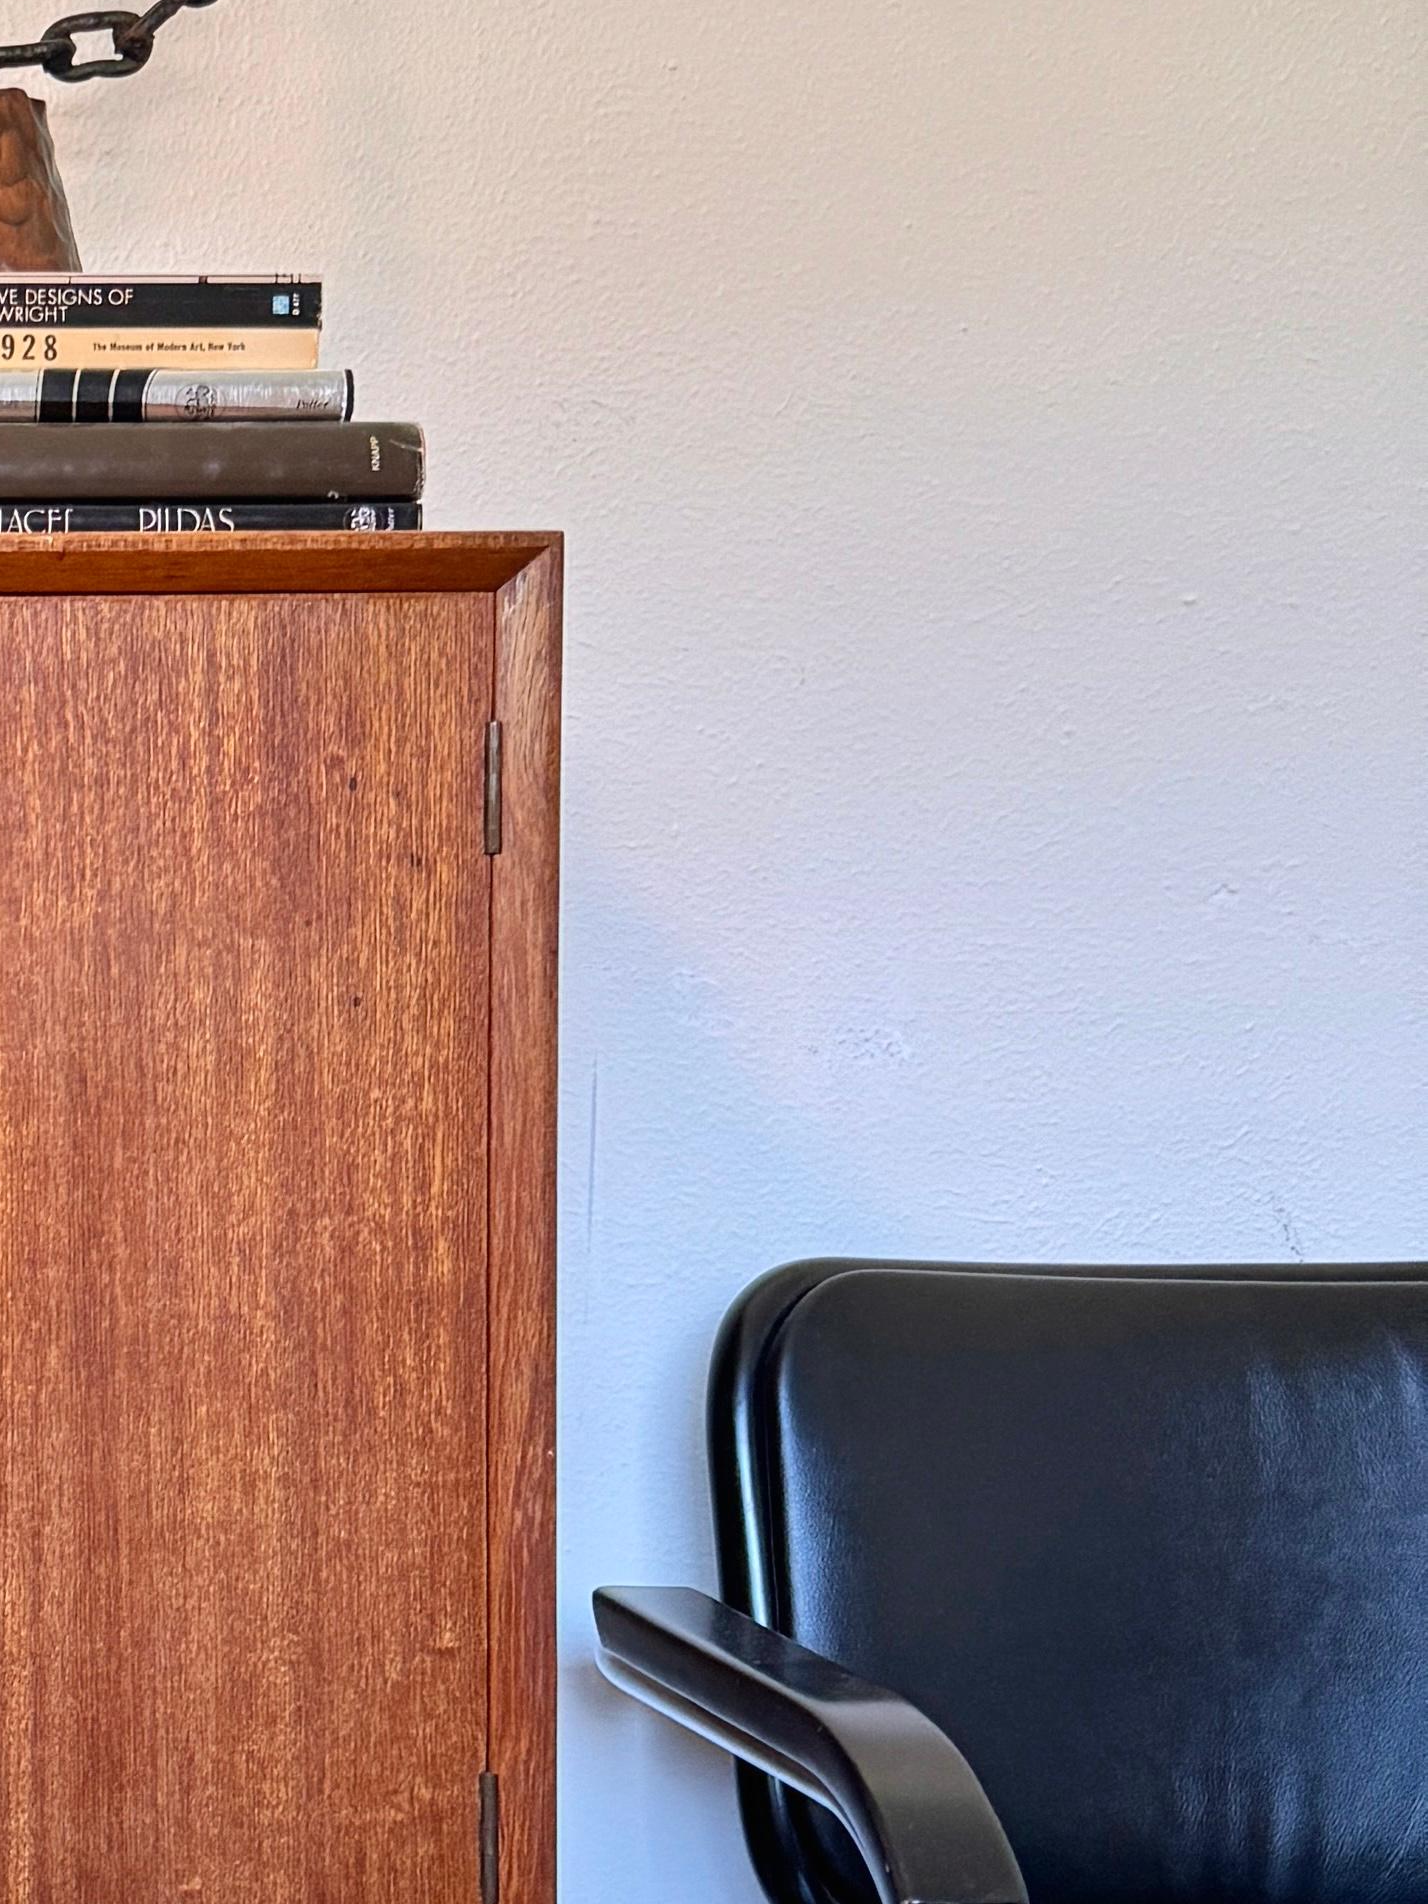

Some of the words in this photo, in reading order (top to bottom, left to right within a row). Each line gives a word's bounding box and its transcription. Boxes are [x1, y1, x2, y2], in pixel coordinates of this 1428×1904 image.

[24, 288, 103, 306] DESIGNS
[107, 288, 135, 305] OF
[93, 342, 107, 352] The
[110, 342, 143, 352] Museum
[145, 342, 154, 352] of
[157, 342, 187, 352] Modern
[208, 342, 225, 352] New
[227, 342, 246, 352] York
[369, 436, 381, 472] KNAPP
